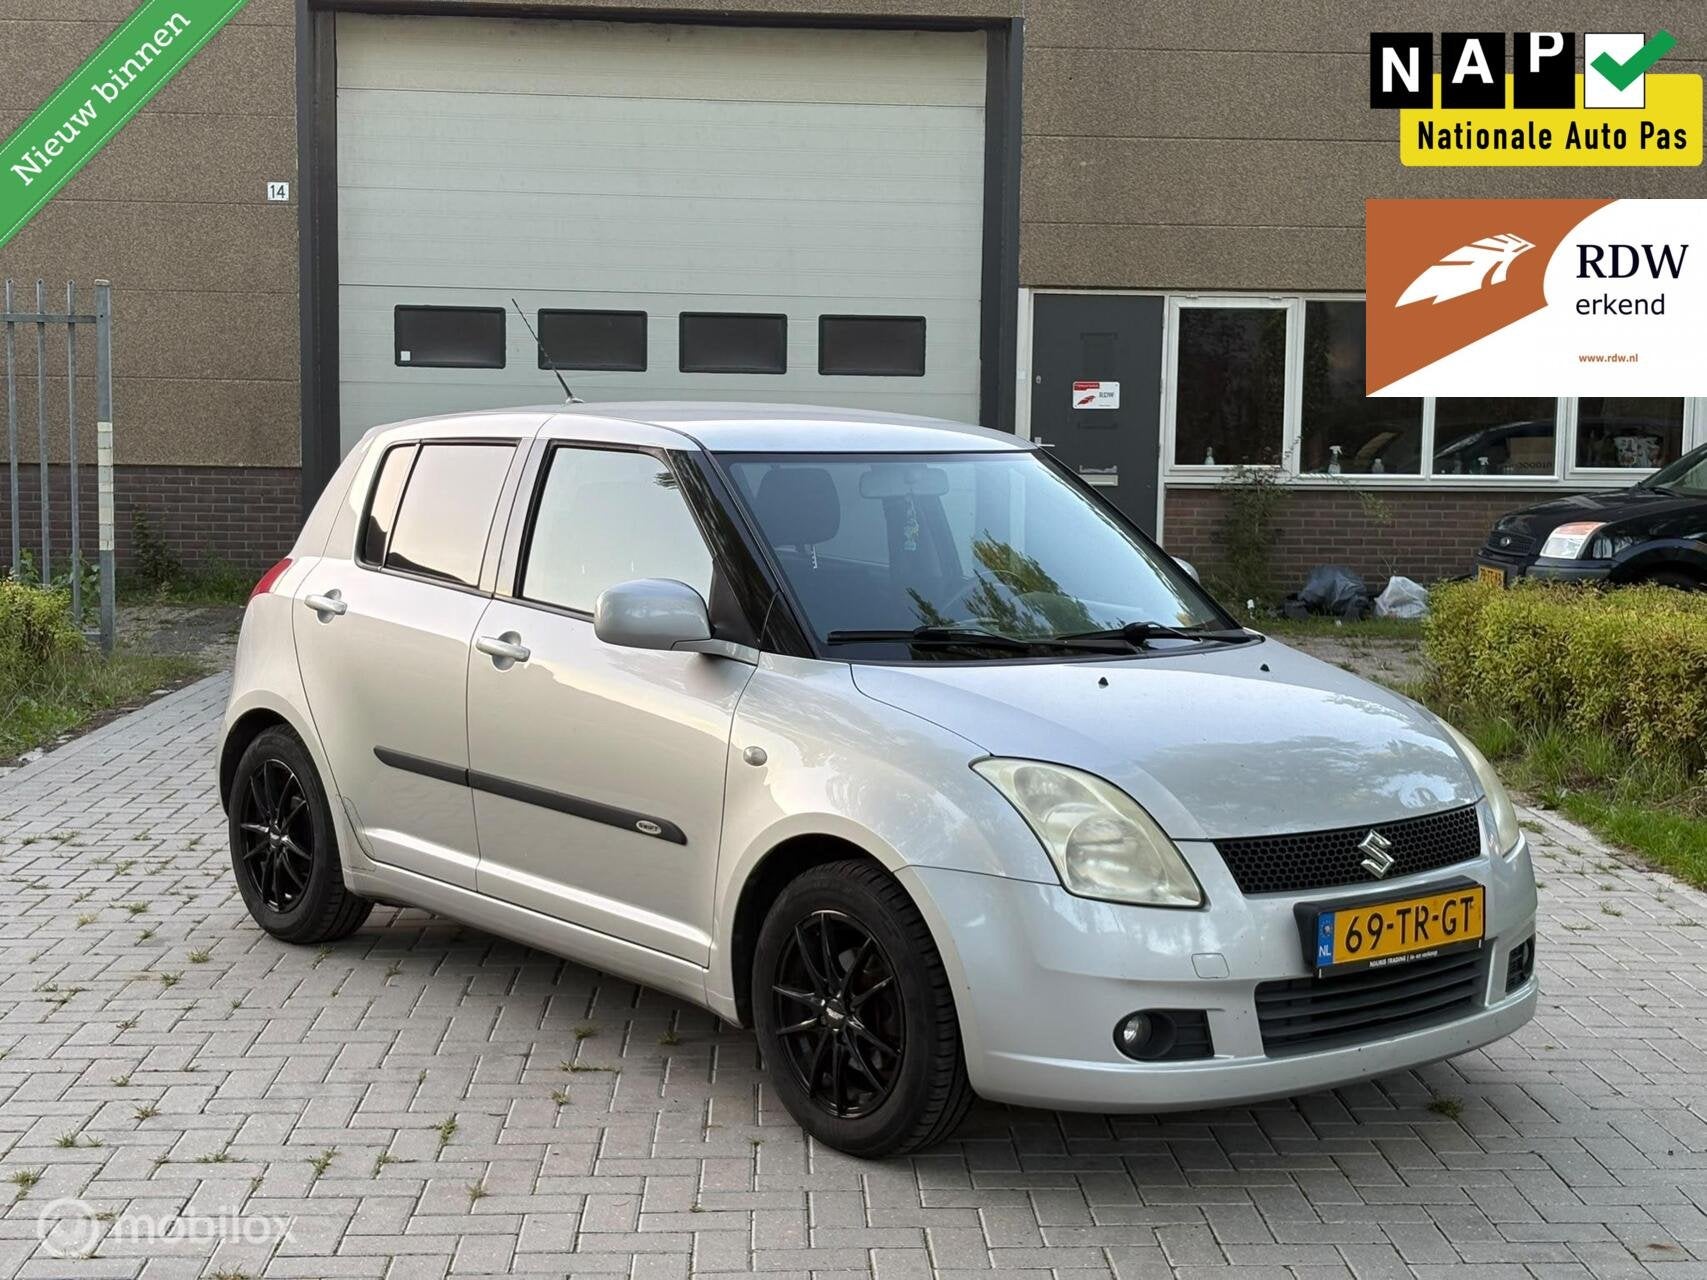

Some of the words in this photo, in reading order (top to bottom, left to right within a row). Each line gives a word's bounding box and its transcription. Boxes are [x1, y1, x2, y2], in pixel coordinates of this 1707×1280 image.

[270, 185, 285, 199] 14
[1345, 896, 1474, 953] 69-TR-GT
[1319, 943, 1332, 957] NL
